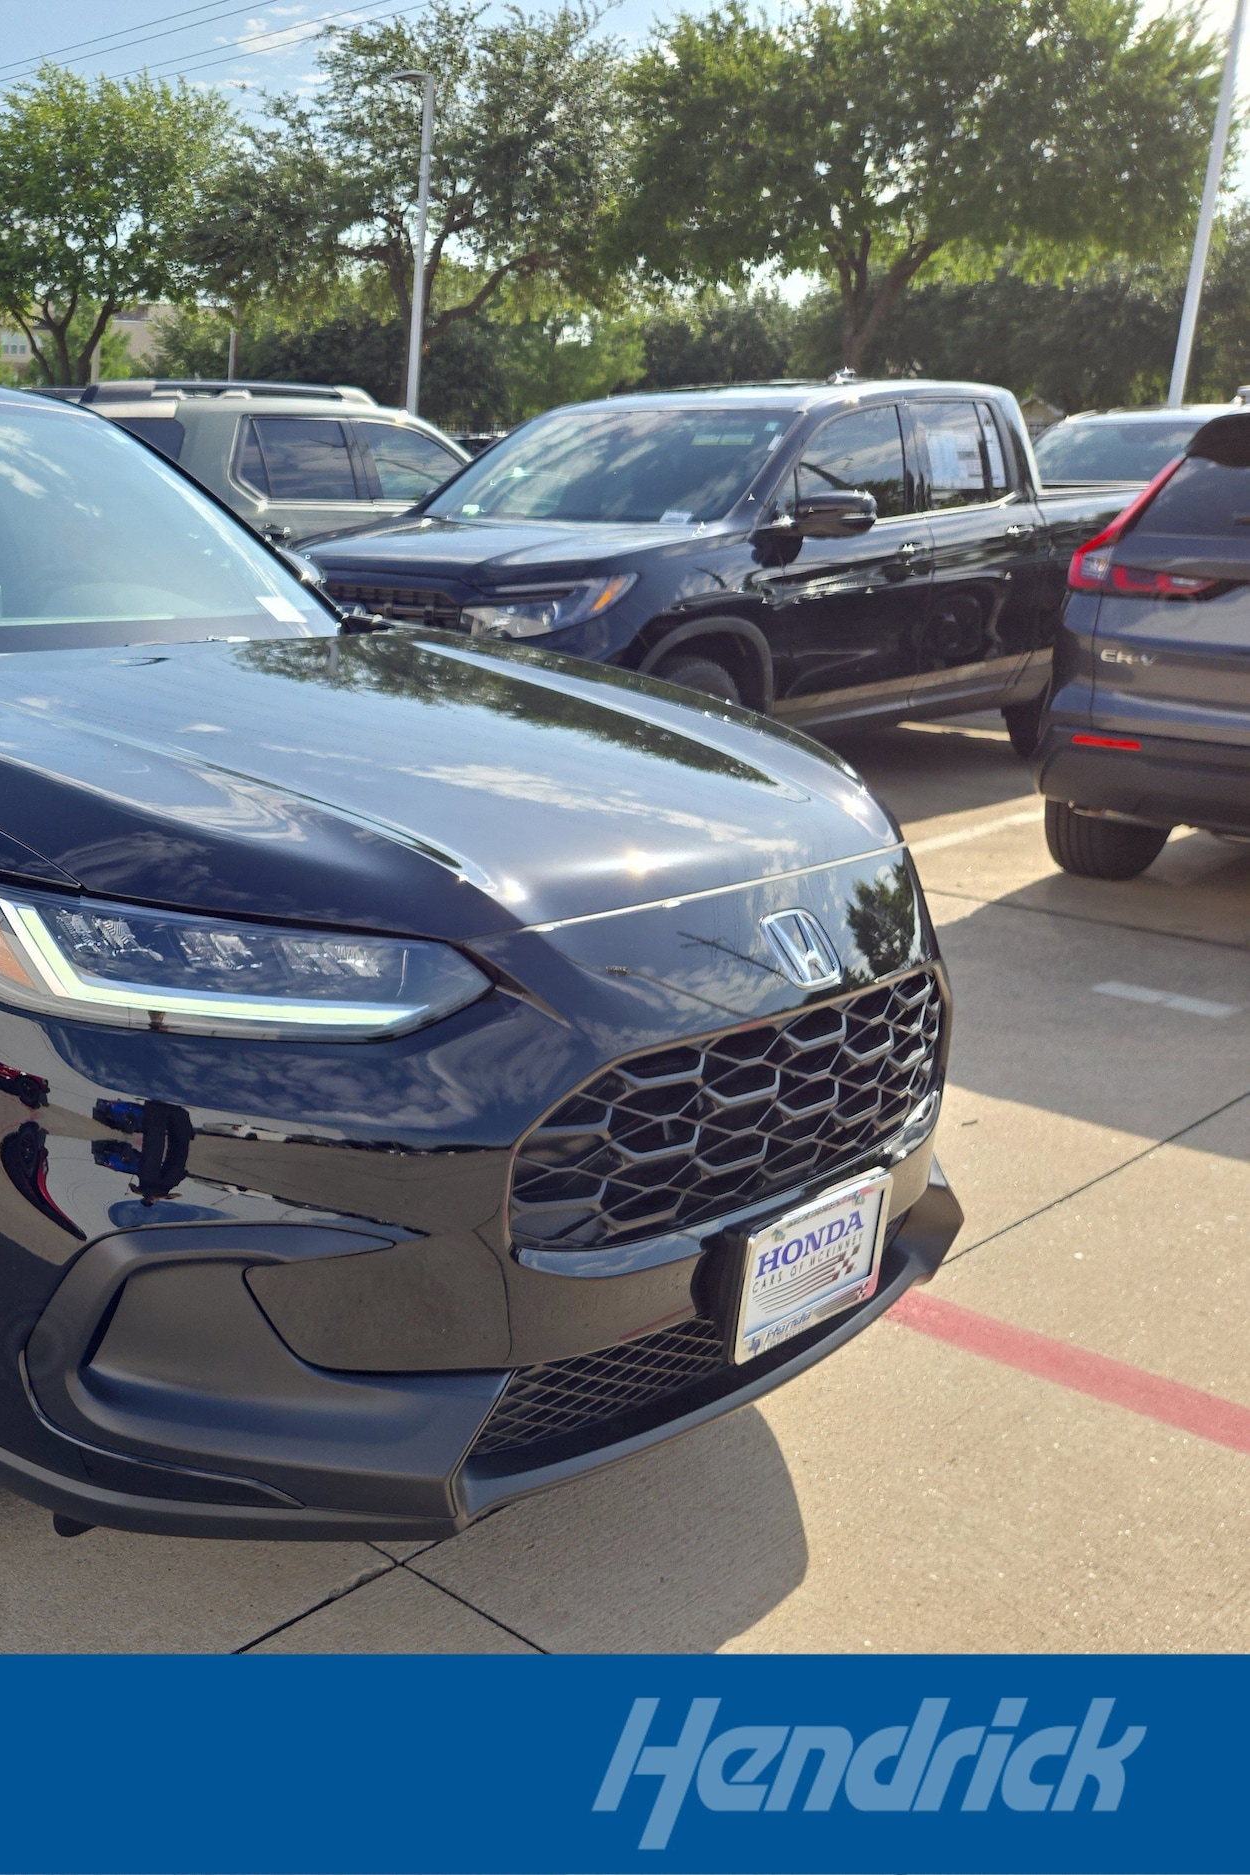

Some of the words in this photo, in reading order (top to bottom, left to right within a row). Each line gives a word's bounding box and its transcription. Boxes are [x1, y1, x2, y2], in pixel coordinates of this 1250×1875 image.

[752, 1270, 783, 1294] CARS
[790, 1260, 805, 1277] OF
[809, 1231, 864, 1267] MCKINNEY
[755, 1210, 865, 1279] HONDA
